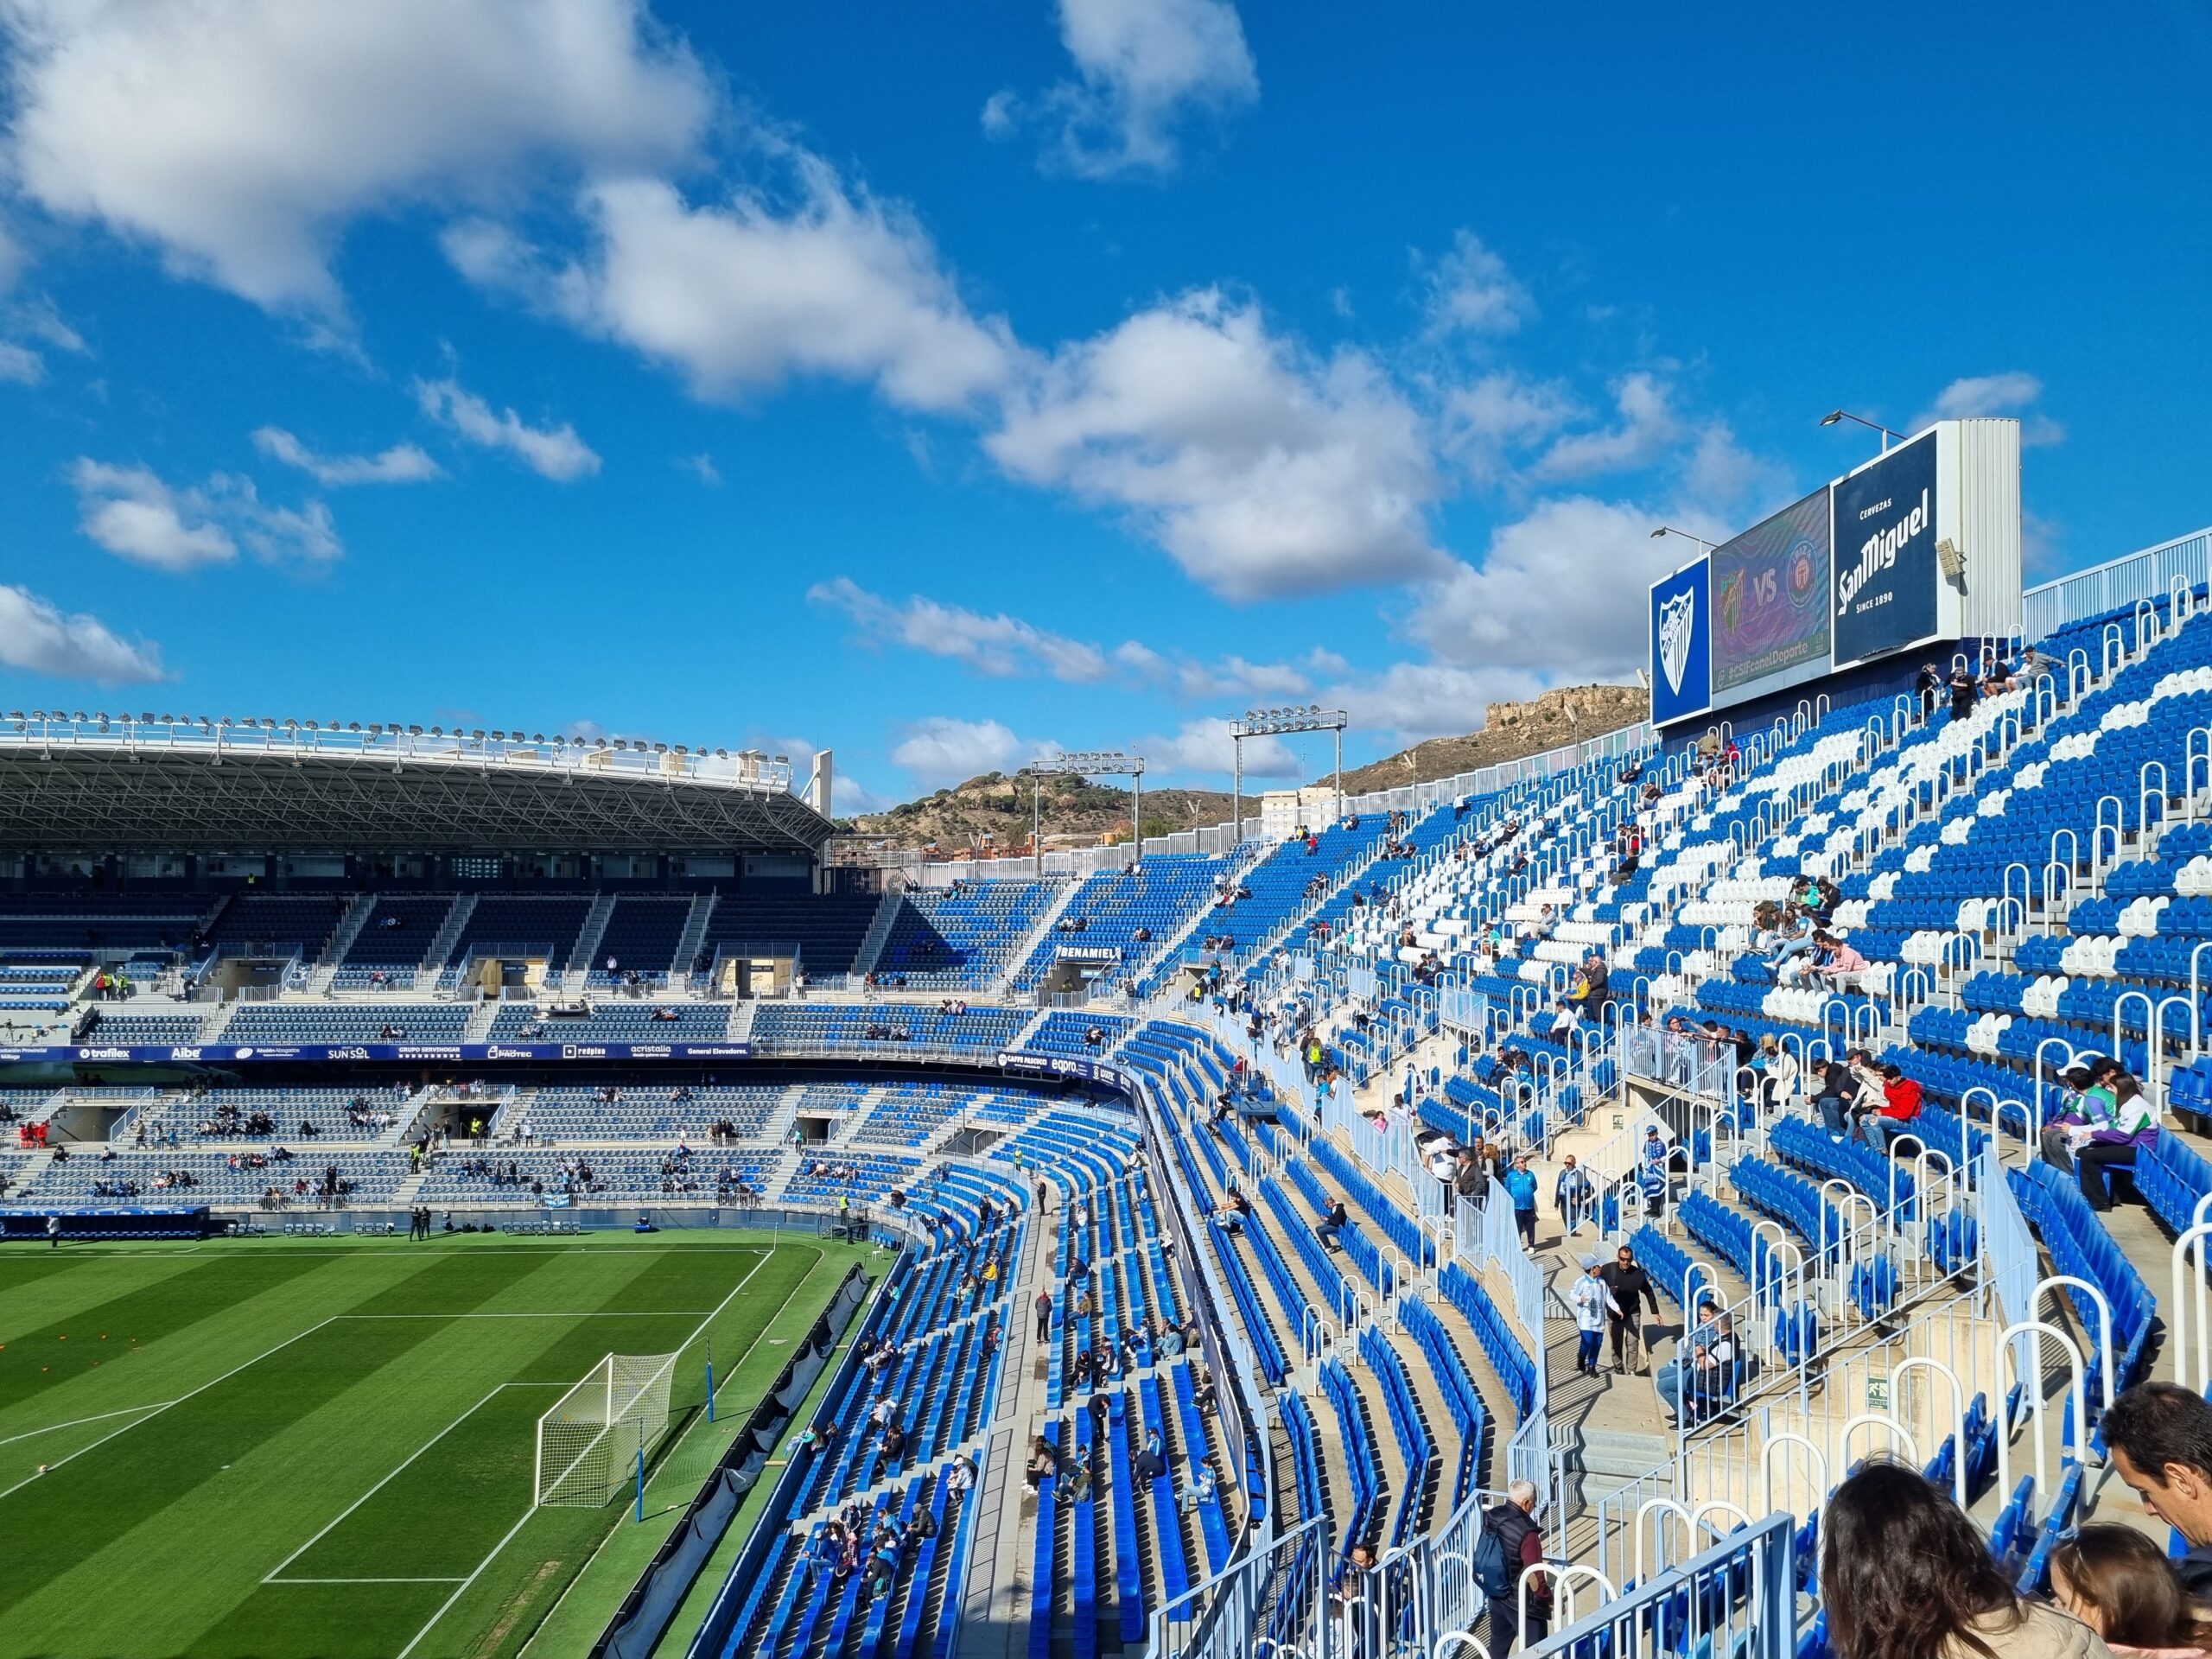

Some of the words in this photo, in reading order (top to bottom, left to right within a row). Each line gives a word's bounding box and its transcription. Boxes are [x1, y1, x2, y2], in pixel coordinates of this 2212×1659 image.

[1859, 498, 1892, 520] CERVEZAS
[1753, 568, 1777, 607] VS
[1856, 599, 1873, 613] SINCE
[1875, 591, 1893, 606] 1890
[1060, 946, 1116, 959] BENAMIEL
[91, 1048, 130, 1058] trafilex
[328, 1050, 348, 1059] SUN
[1024, 1057, 1047, 1065] PASCUCCI
